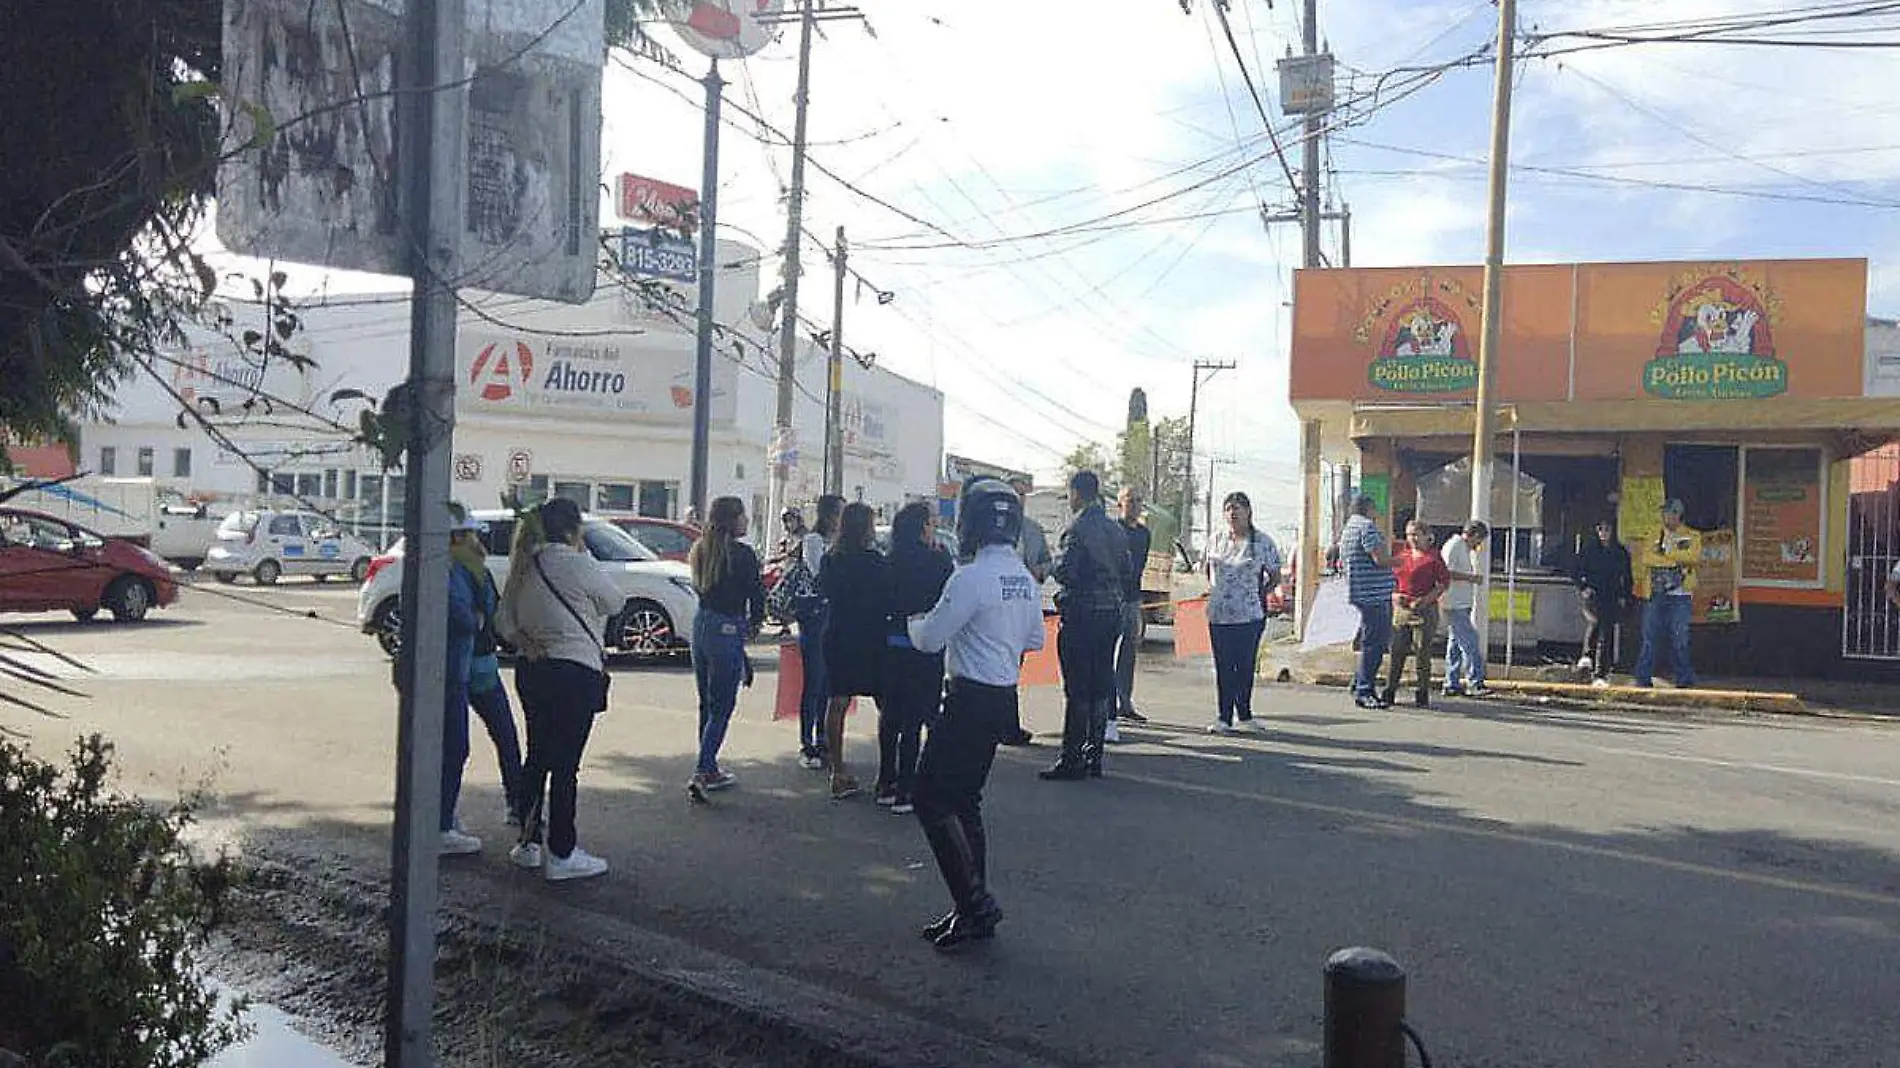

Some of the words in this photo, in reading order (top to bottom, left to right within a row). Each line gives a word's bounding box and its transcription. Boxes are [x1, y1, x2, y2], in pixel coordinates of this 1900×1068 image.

[544, 360, 625, 393] Ahorro
[1375, 364, 1420, 381] Pollo
[1651, 364, 1708, 386] Pollo
[1713, 360, 1780, 384] Picón
